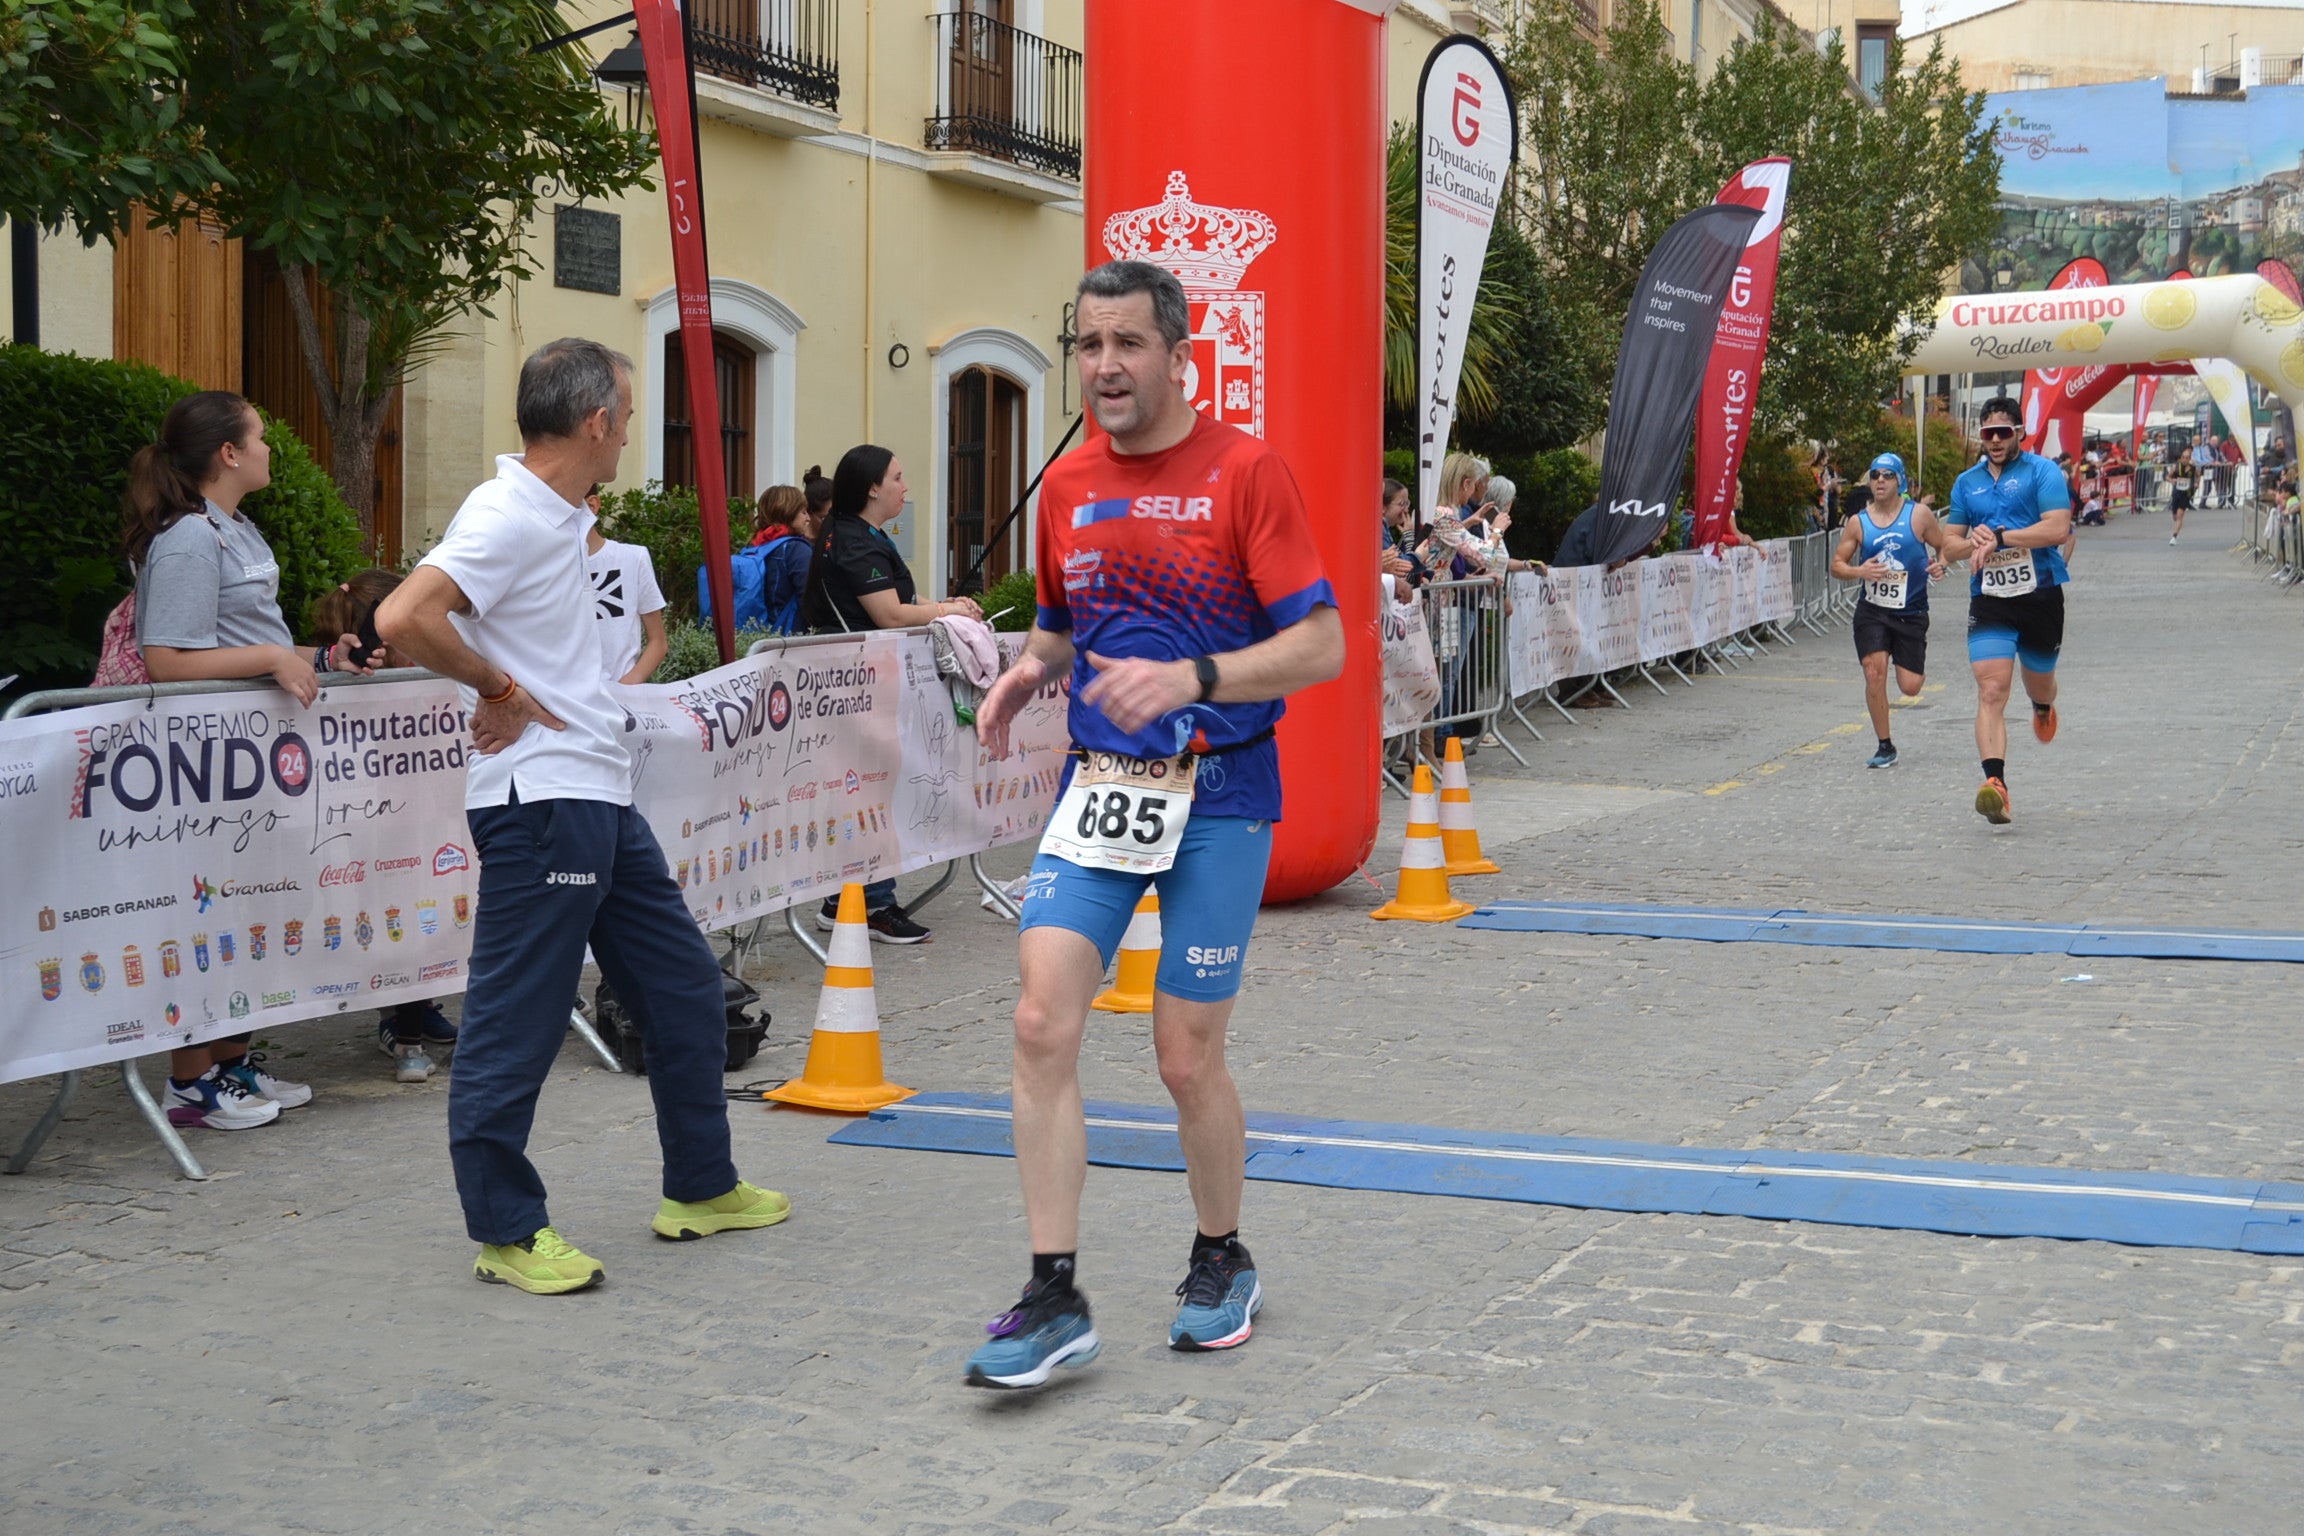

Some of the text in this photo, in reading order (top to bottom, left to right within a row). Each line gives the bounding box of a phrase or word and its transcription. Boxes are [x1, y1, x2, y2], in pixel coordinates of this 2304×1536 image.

[2019, 117, 2051, 130] Turismo
[1427, 135, 1497, 184] Diputación
[1426, 163, 1495, 209] de Granada
[1426, 194, 1465, 219] Avanzamos
[1649, 296, 1673, 311] that
[1653, 280, 1712, 305] Movement
[1643, 312, 1686, 334] inspires
[1720, 307, 1764, 326] iputació
[1952, 294, 2127, 328] Cruzcampo
[1725, 321, 1761, 339] Granad
[1970, 333, 2055, 360] Radler
[1422, 253, 1456, 469] eportes
[1132, 495, 1213, 522] SEUR
[1984, 565, 2033, 587] 3035
[1870, 581, 1900, 599] 195
[796, 661, 876, 697] Diputación
[678, 683, 729, 710] GRAN
[770, 698, 787, 716] 24
[798, 690, 873, 720] de Granada
[90, 710, 296, 754] GRAN PREMIO DE
[82, 732, 313, 818] FONDO
[280, 751, 306, 777] 24
[325, 752, 358, 783] de
[1096, 752, 1167, 780] ONDO
[99, 759, 406, 855] universo Lorca
[1077, 790, 1168, 845] 685
[319, 860, 367, 887] Coca-Cola
[375, 856, 422, 872] Cruzcampo
[546, 871, 597, 886] Joma
[220, 877, 302, 897] Granada
[63, 894, 178, 923] SABOR GRANADA
[1185, 945, 1239, 966] SEUR
[106, 1019, 144, 1034] IDEAL
